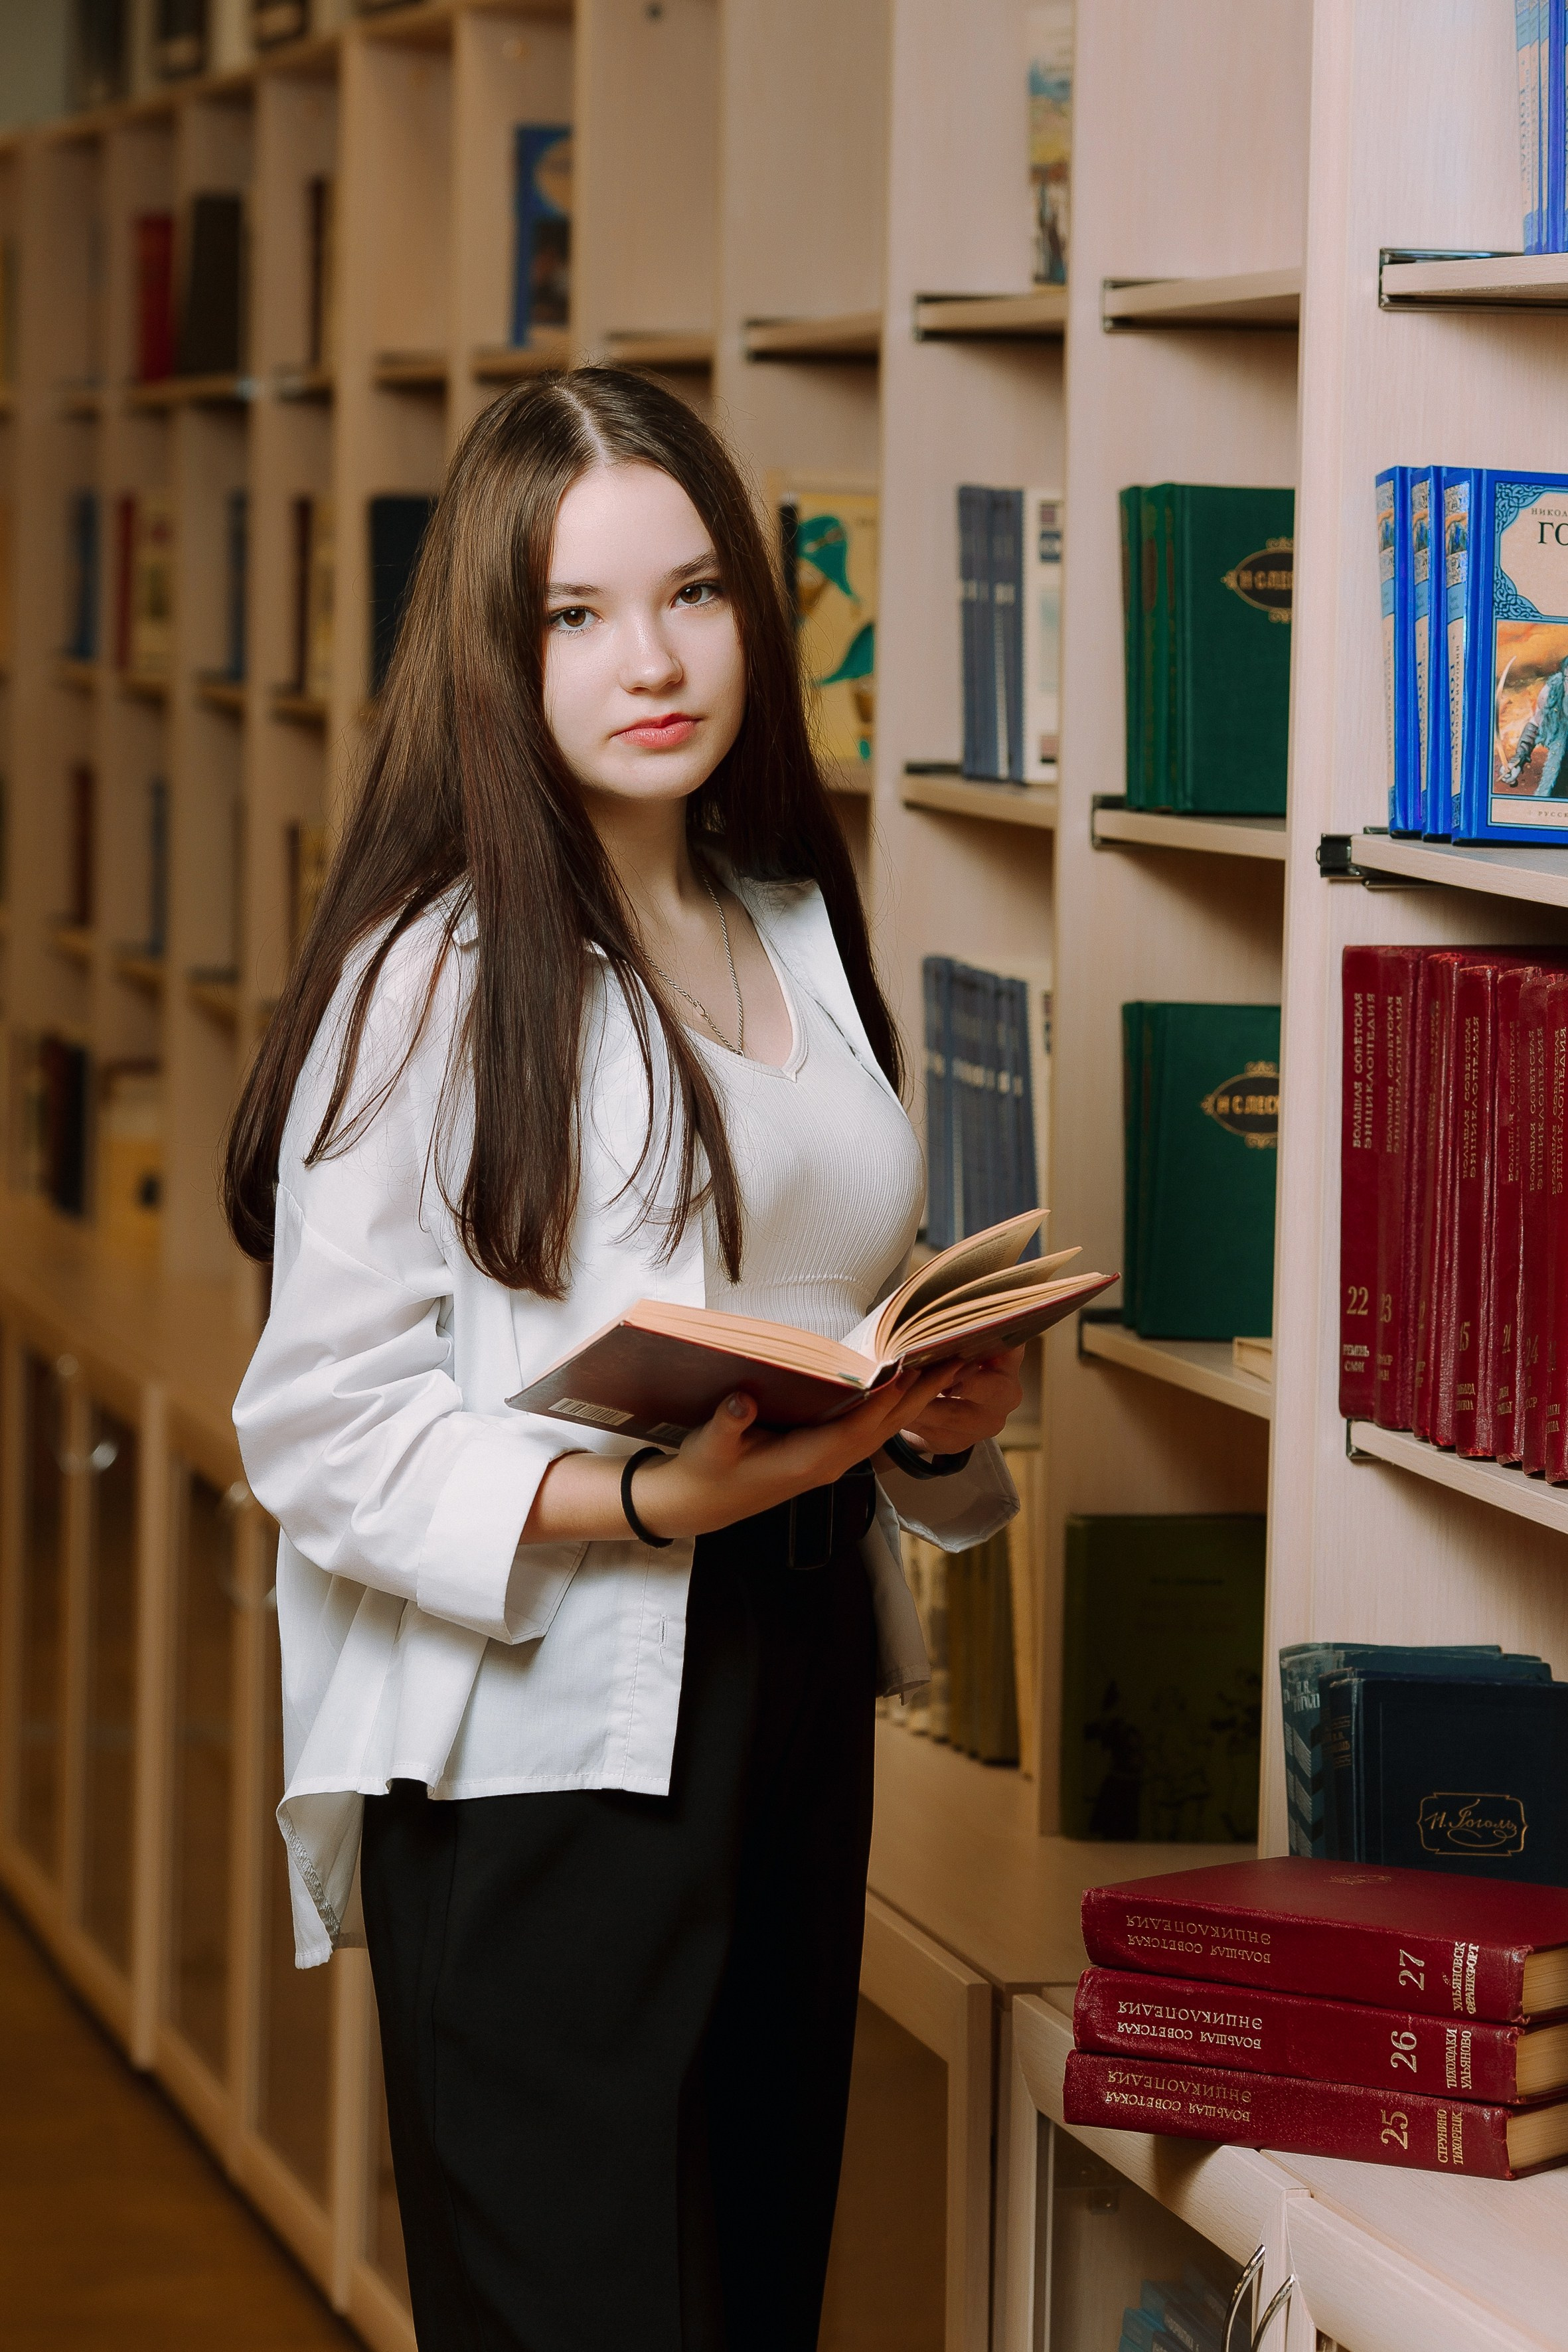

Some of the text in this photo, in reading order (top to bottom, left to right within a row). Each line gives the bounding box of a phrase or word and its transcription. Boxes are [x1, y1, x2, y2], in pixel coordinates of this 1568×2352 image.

[1352, 992, 1363, 1148] БОЛЬШАЯ СОВЕТСКАЯ
[1364, 992, 1375, 1149] ЭНЦИКЛОПЕДИЯ
[1470, 1016, 1480, 1179] ЭНЦИКЛОПЕДИЯ
[1557, 1026, 1567, 1194] ЭНЦИКЛОПЕДИЯ
[1346, 1286, 1369, 1316] 22
[1126, 1915, 1271, 1945] ЭНЦИКЛОПЕДИЯ
[1128, 1934, 1271, 1964] БОЛЬШАЯ СОВЕТСКАЯ
[1399, 1949, 1425, 1991] 27
[1452, 1941, 1466, 2011] УЛЬЯНОВСК
[1465, 1943, 1479, 2014] ФРАНКФОРТ
[1117, 2022, 1261, 2049] БОЛЬШАЯ СОВЕТСКАЯ
[1118, 2001, 1263, 2029] ЭНЦИКЛОПЕДИЯ
[1390, 2031, 1417, 2073] 26
[1445, 2027, 1457, 2088] ТИХОХОДКИ
[1460, 2030, 1472, 2090] УЛЬЯНОВО
[1105, 2091, 1250, 2122] БОЛЬШАЯ СОВЕТСКАЯ
[1107, 2071, 1251, 2103] ЭНЦИКЛОПЕДИЯ
[1381, 2109, 1408, 2150] 25
[1437, 2108, 1449, 2163] СТРУНИНО
[1452, 2110, 1464, 2165] ТИХОРЕЦК
